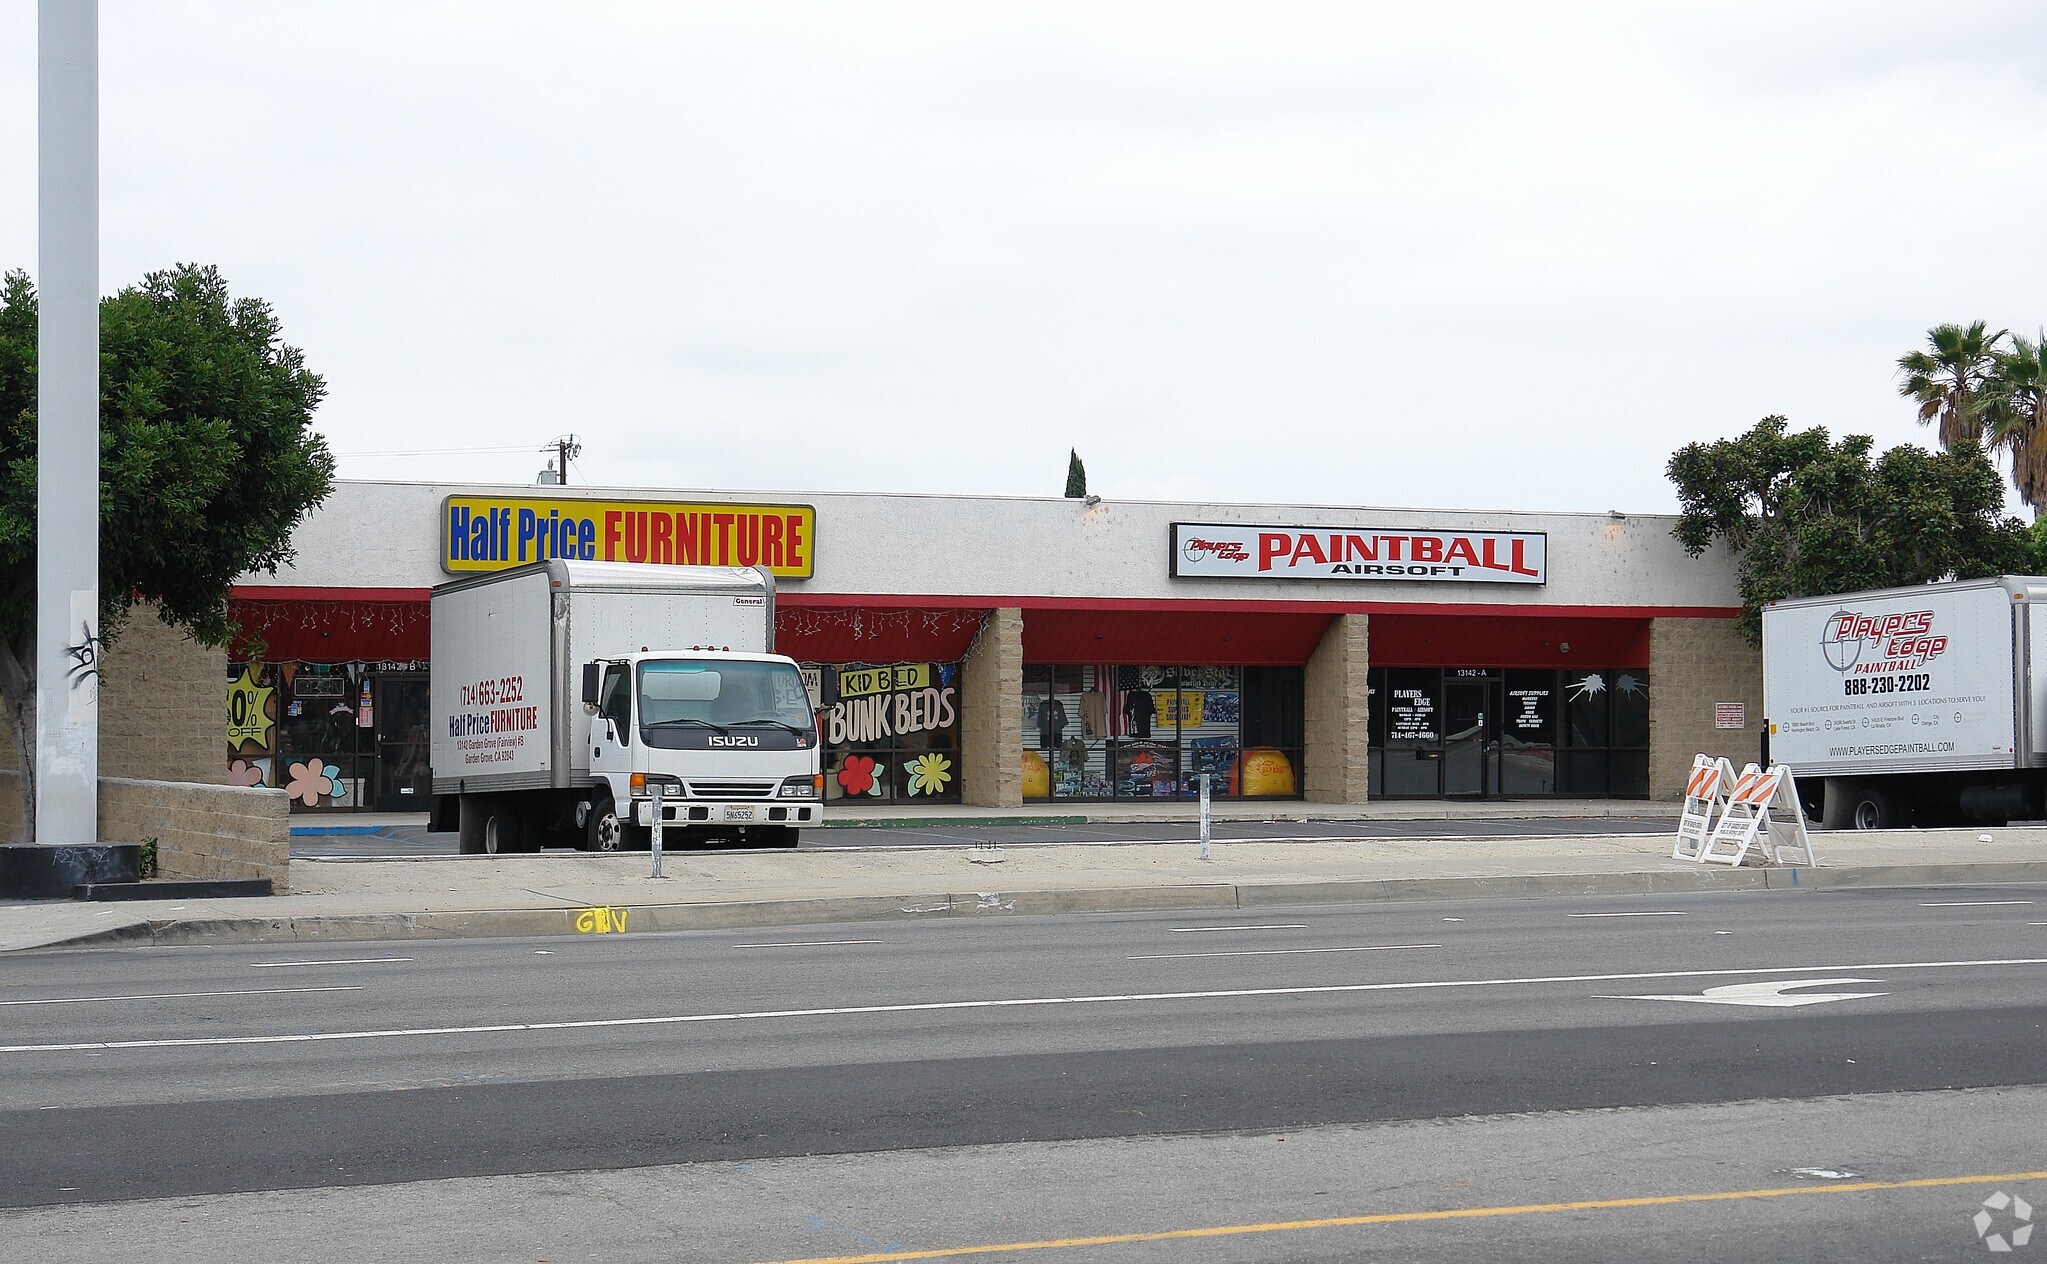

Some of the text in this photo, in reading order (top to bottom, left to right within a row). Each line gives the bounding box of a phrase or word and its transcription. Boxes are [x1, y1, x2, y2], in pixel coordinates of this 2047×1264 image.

[450, 506, 803, 567] Half Price FURNITURE
[1190, 539, 1244, 561] Players
[1218, 550, 1250, 564] Edge
[1258, 532, 1539, 578] PAINTBALL
[1330, 563, 1467, 577] AIRSOFT
[735, 598, 763, 606] General
[1831, 610, 1935, 649] Players
[1884, 635, 1949, 667] Edge
[1457, 669, 1477, 677] 13142
[1854, 659, 1917, 675] PAINTBALL
[845, 668, 918, 694] KID BED
[1844, 673, 1931, 696] 888-230-2202
[460, 675, 523, 707] (714) 663-2252
[1394, 689, 1422, 698] PLAYERS
[227, 690, 259, 727] 0%
[1414, 698, 1430, 706] EDGE
[1810, 705, 1829, 713] SOURCE
[1840, 703, 1865, 711] PAINTBALL
[1918, 697, 1947, 706] LOCATIONS
[449, 706, 538, 737] Half Price FURNITURE
[829, 688, 955, 745] BUNK BEDS
[228, 728, 262, 737] OFF
[469, 738, 483, 750] Garden
[484, 737, 497, 749] Grove
[707, 736, 759, 747] ISUZU
[1829, 742, 1955, 757] WWW.PLAYERSEDGEPAINTBALL.COM
[465, 753, 480, 764] Garden
[494, 751, 501, 762] CA
